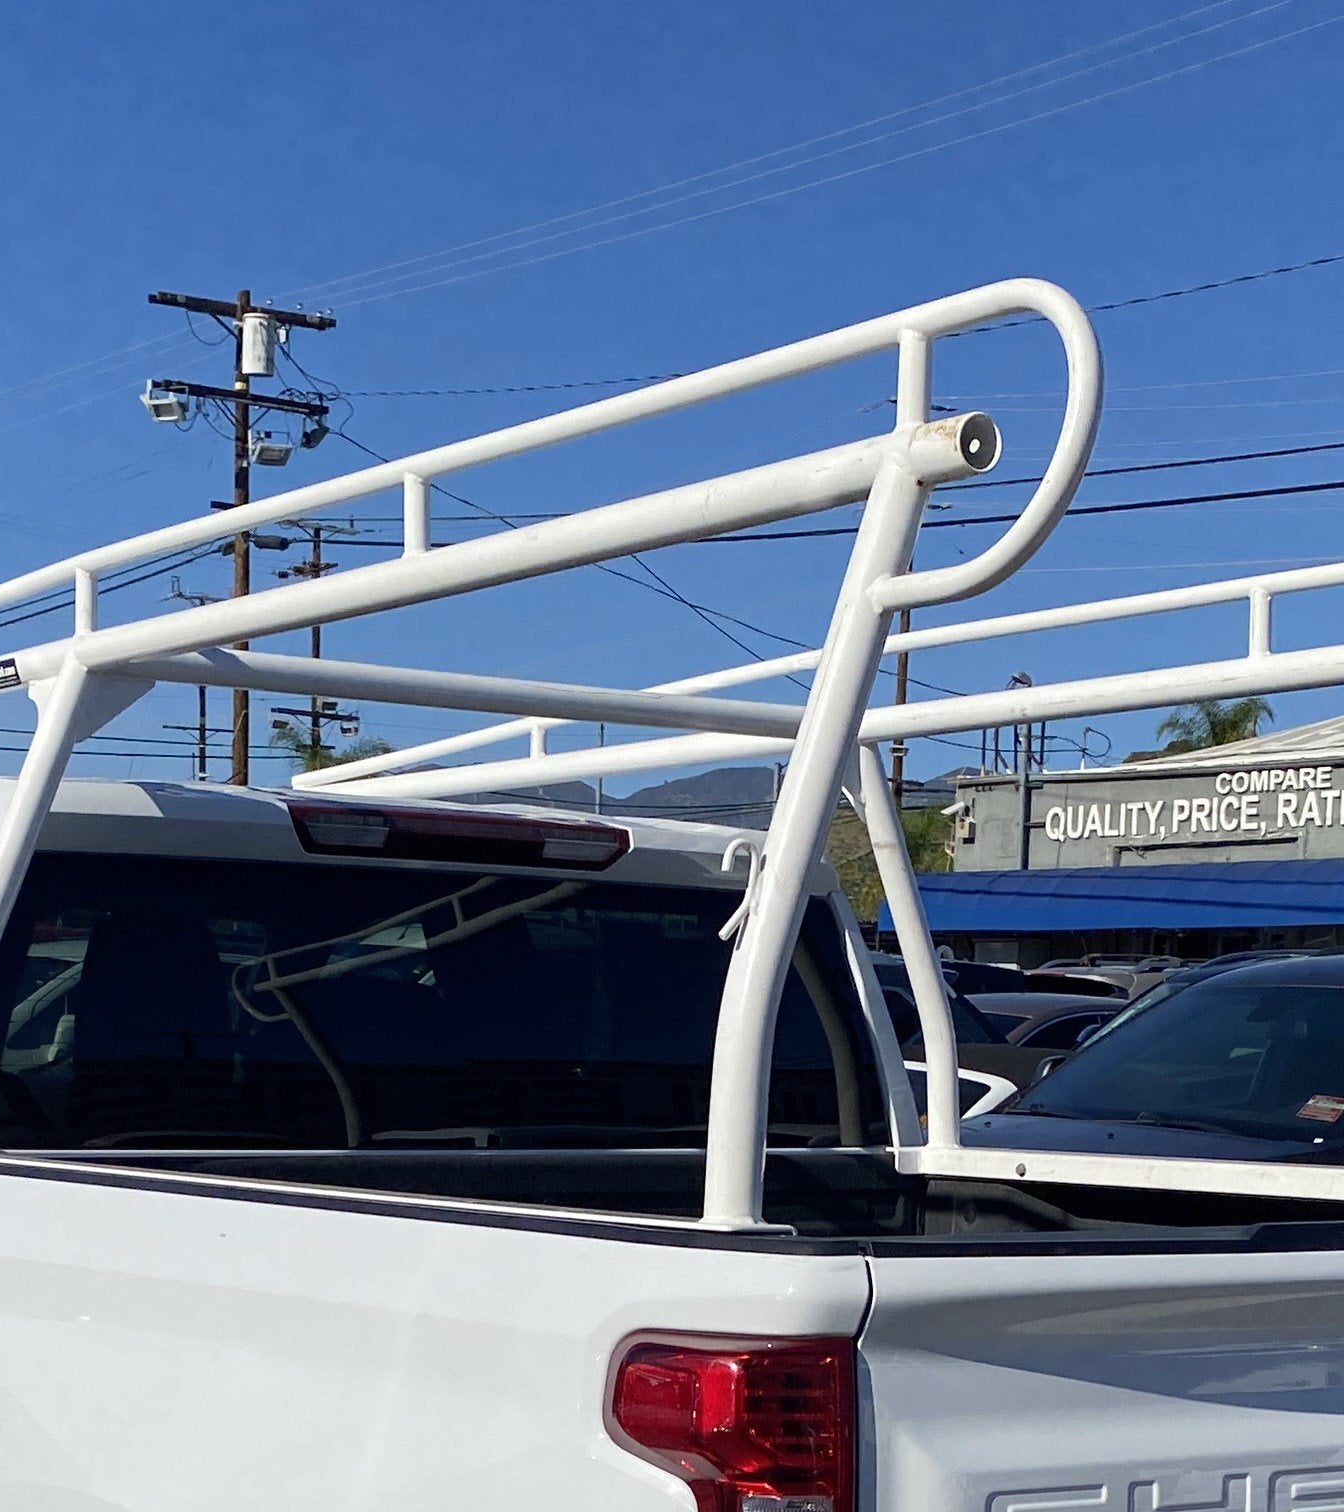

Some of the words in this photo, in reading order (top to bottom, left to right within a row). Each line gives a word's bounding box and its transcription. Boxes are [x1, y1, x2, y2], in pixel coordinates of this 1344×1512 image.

[1214, 768, 1332, 795] COMPARE
[1045, 800, 1166, 842] QUALITY,
[1170, 795, 1267, 837] PRICE,
